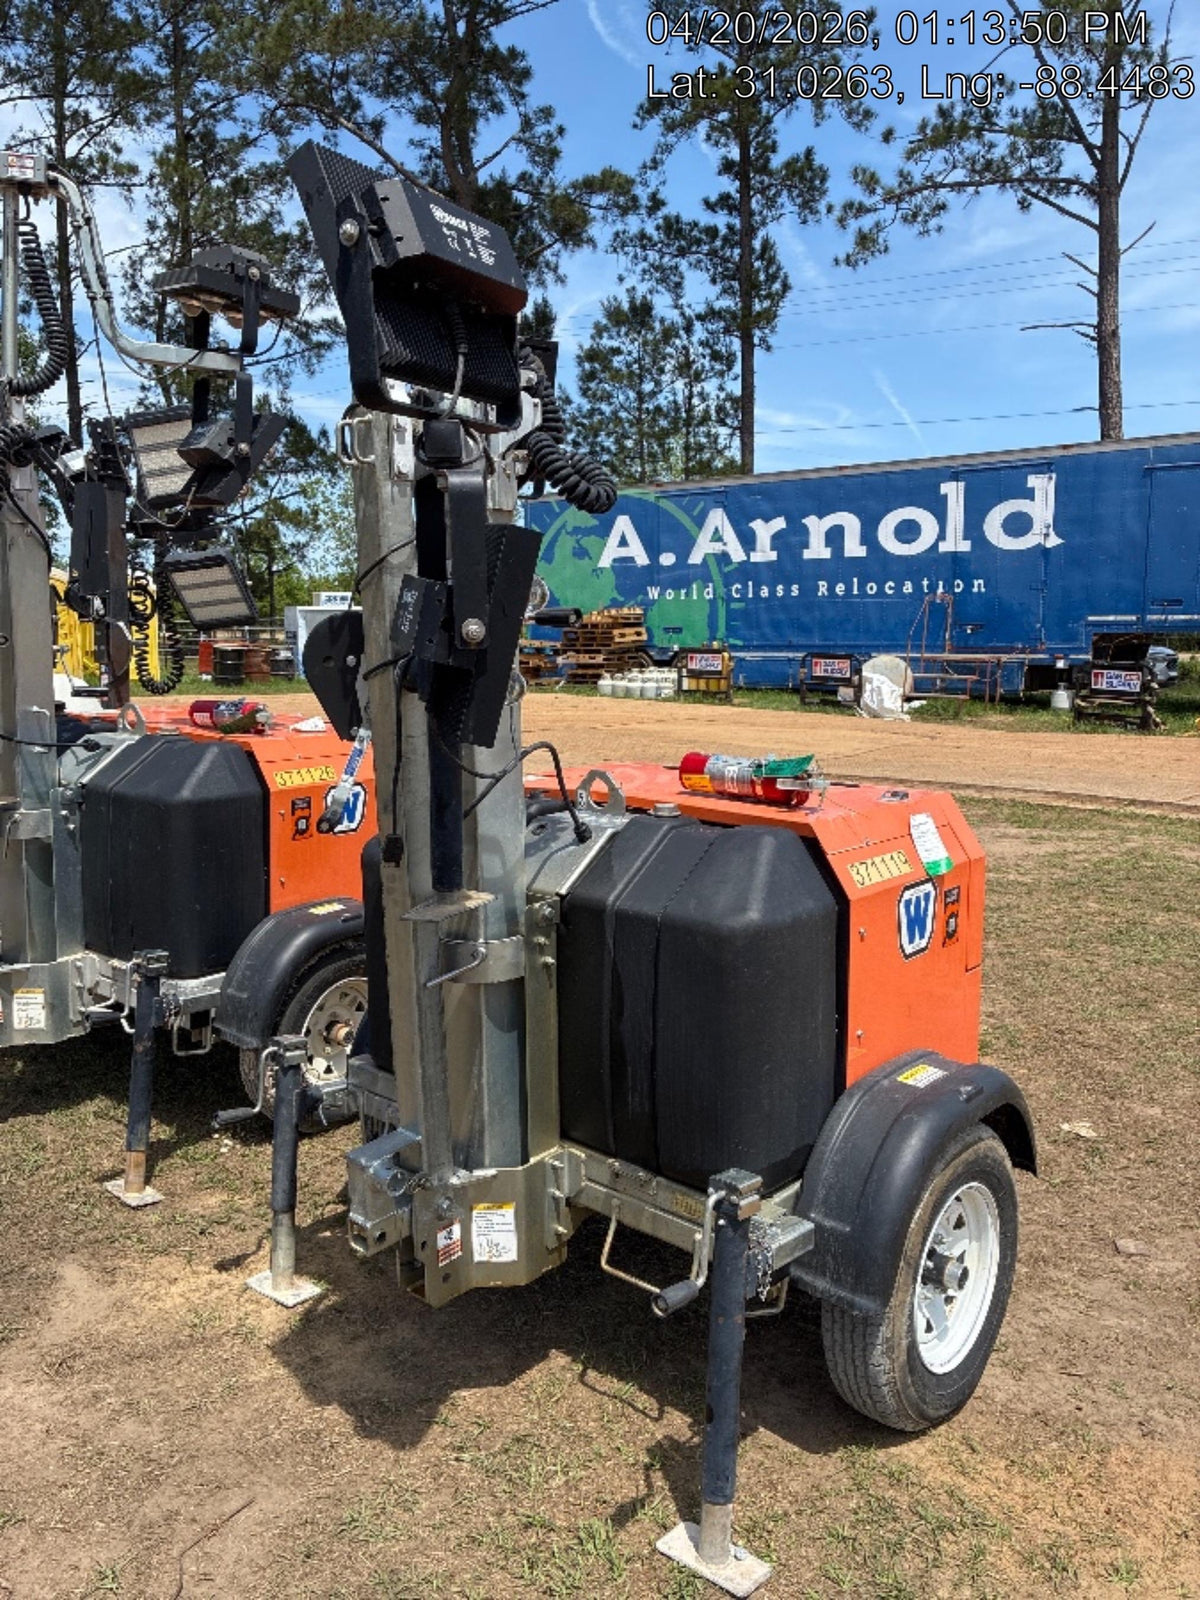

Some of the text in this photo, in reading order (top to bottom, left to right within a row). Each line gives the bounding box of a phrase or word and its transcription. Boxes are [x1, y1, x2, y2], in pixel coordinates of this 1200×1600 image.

[687, 473, 1066, 565] Arnold
[647, 577, 986, 601] World Class Relocation
[904, 890, 932, 944] W
